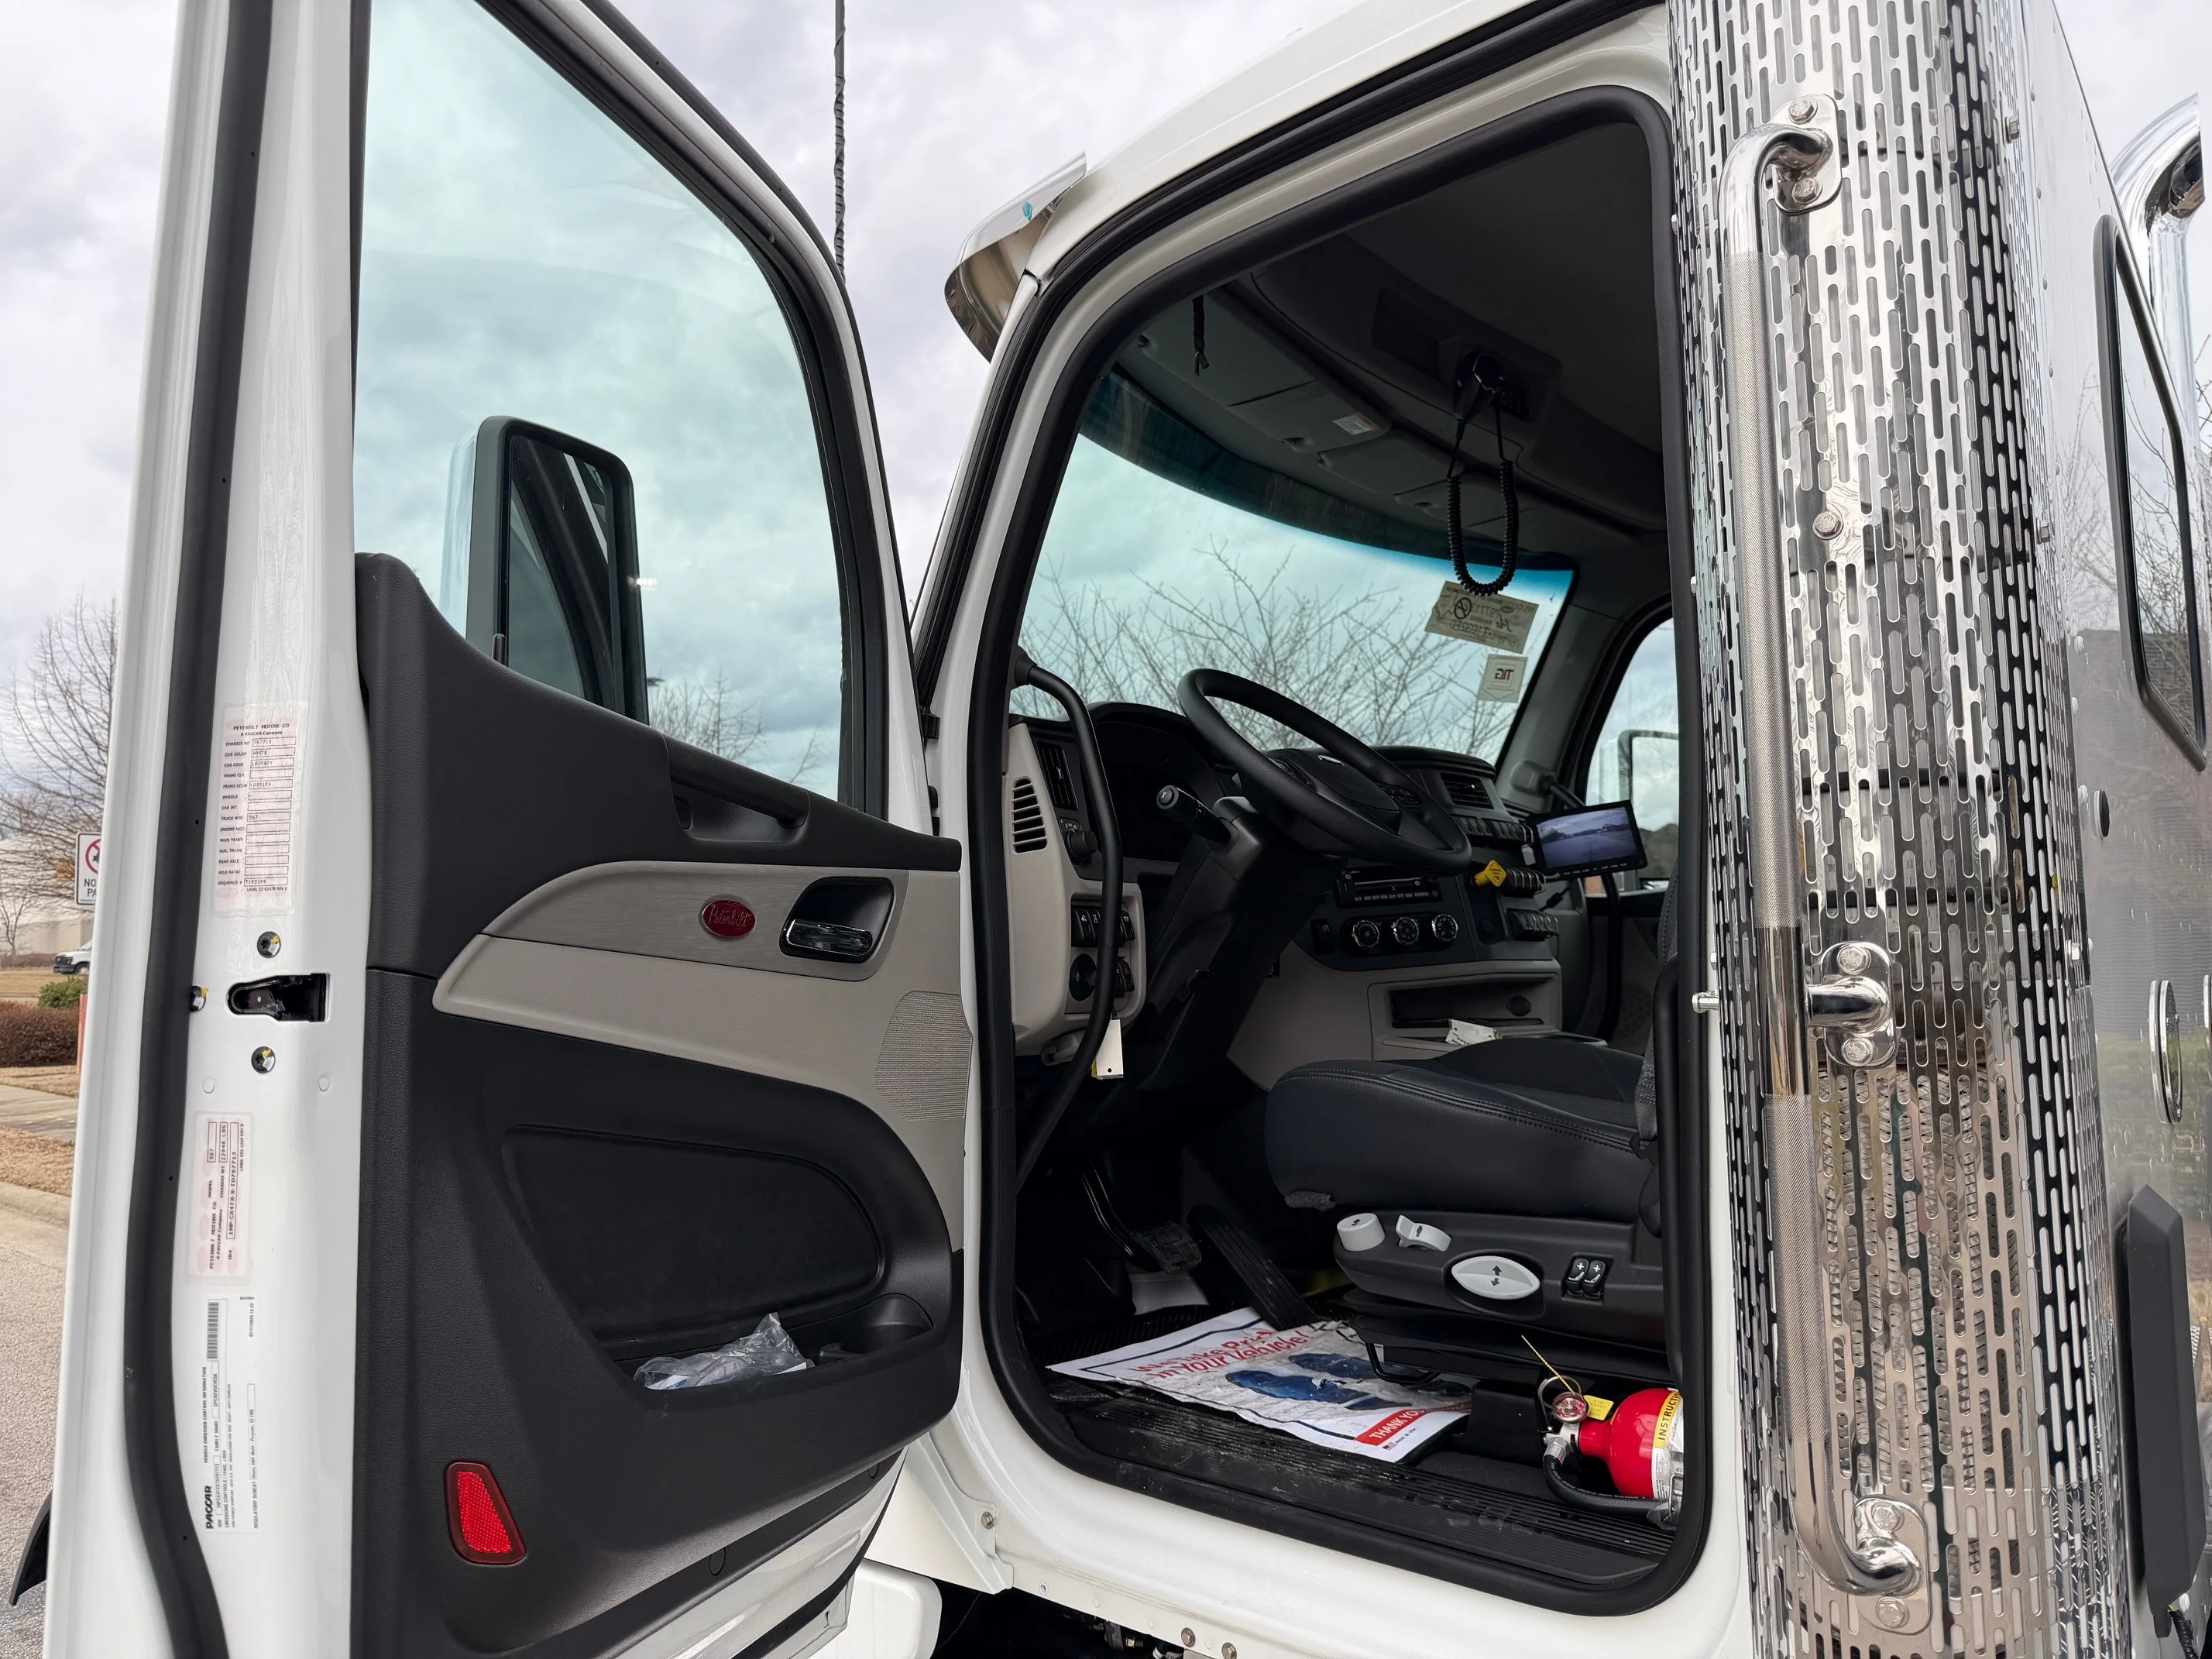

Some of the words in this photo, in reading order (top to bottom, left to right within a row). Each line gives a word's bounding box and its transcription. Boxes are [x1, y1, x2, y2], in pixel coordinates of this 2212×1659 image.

[709, 904, 750, 927] Peterbilt
[221, 1166, 225, 1174] WT
[1369, 1415, 1407, 1438] THANK
[204, 1486, 213, 1529] PACCAR
